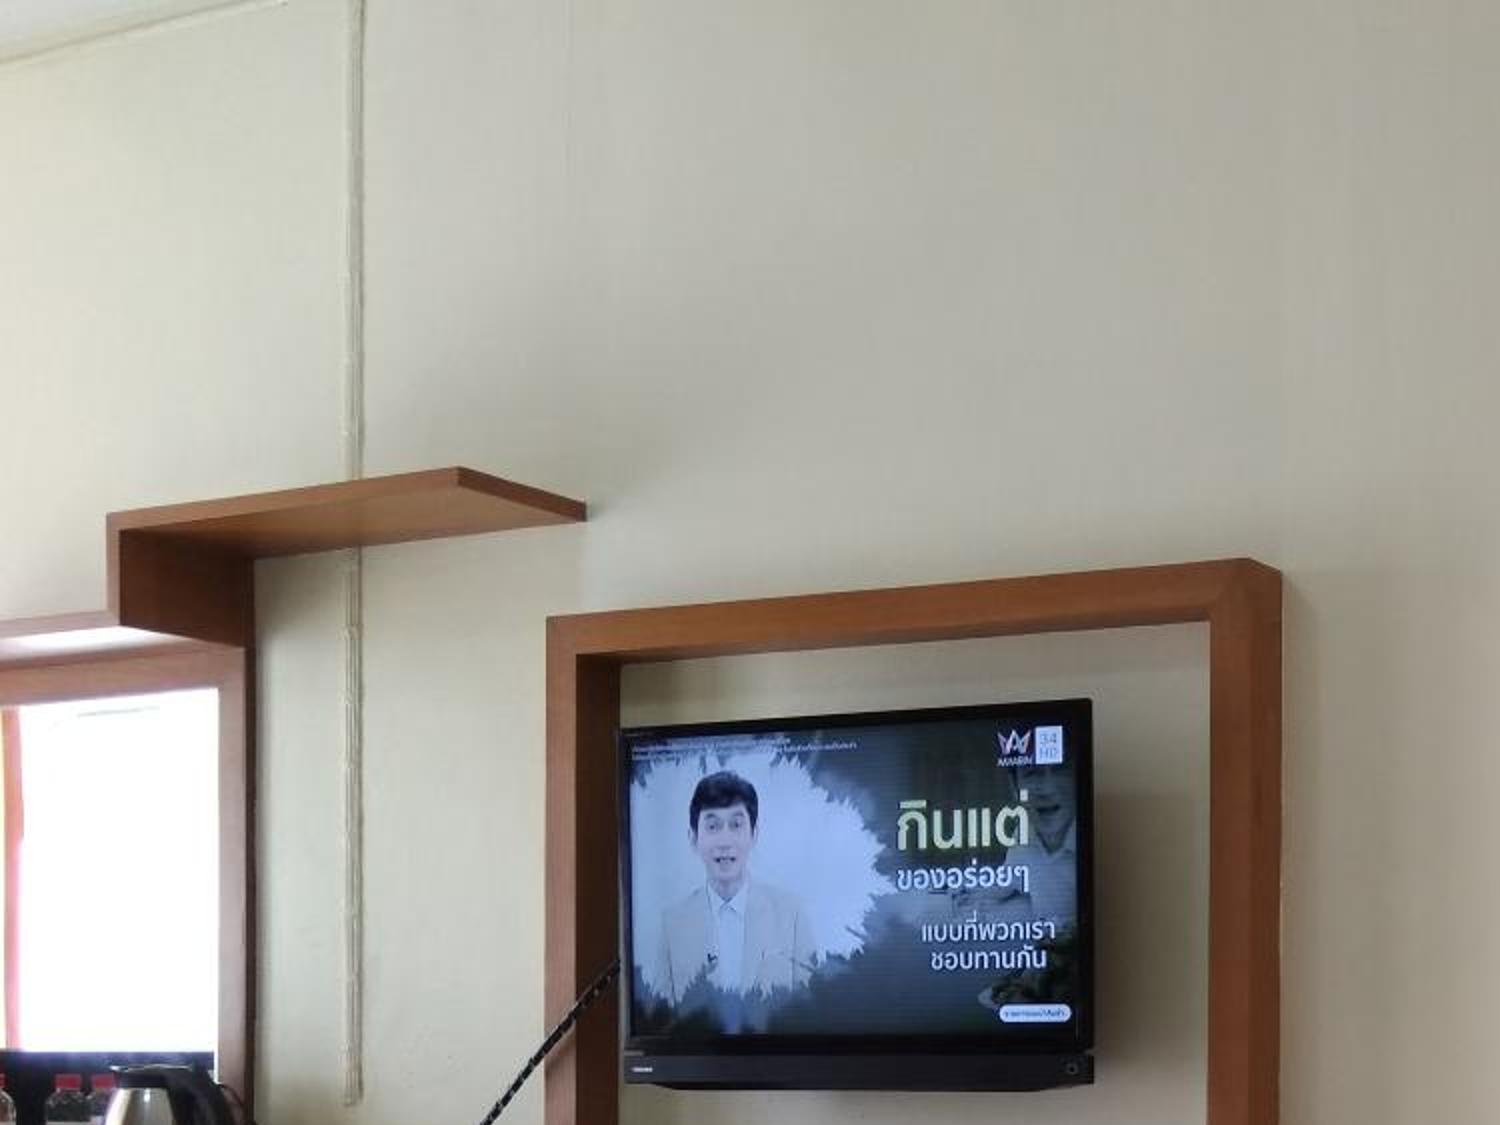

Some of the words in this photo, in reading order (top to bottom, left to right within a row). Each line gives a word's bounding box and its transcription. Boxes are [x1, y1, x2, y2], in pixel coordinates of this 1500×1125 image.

[897, 789, 1030, 851] กินแต่
[897, 858, 1030, 893] ของอร่อยๆ
[921, 910, 1056, 943] แบบที่พวกเรา
[931, 944, 1048, 971] ชอบทานกัน
